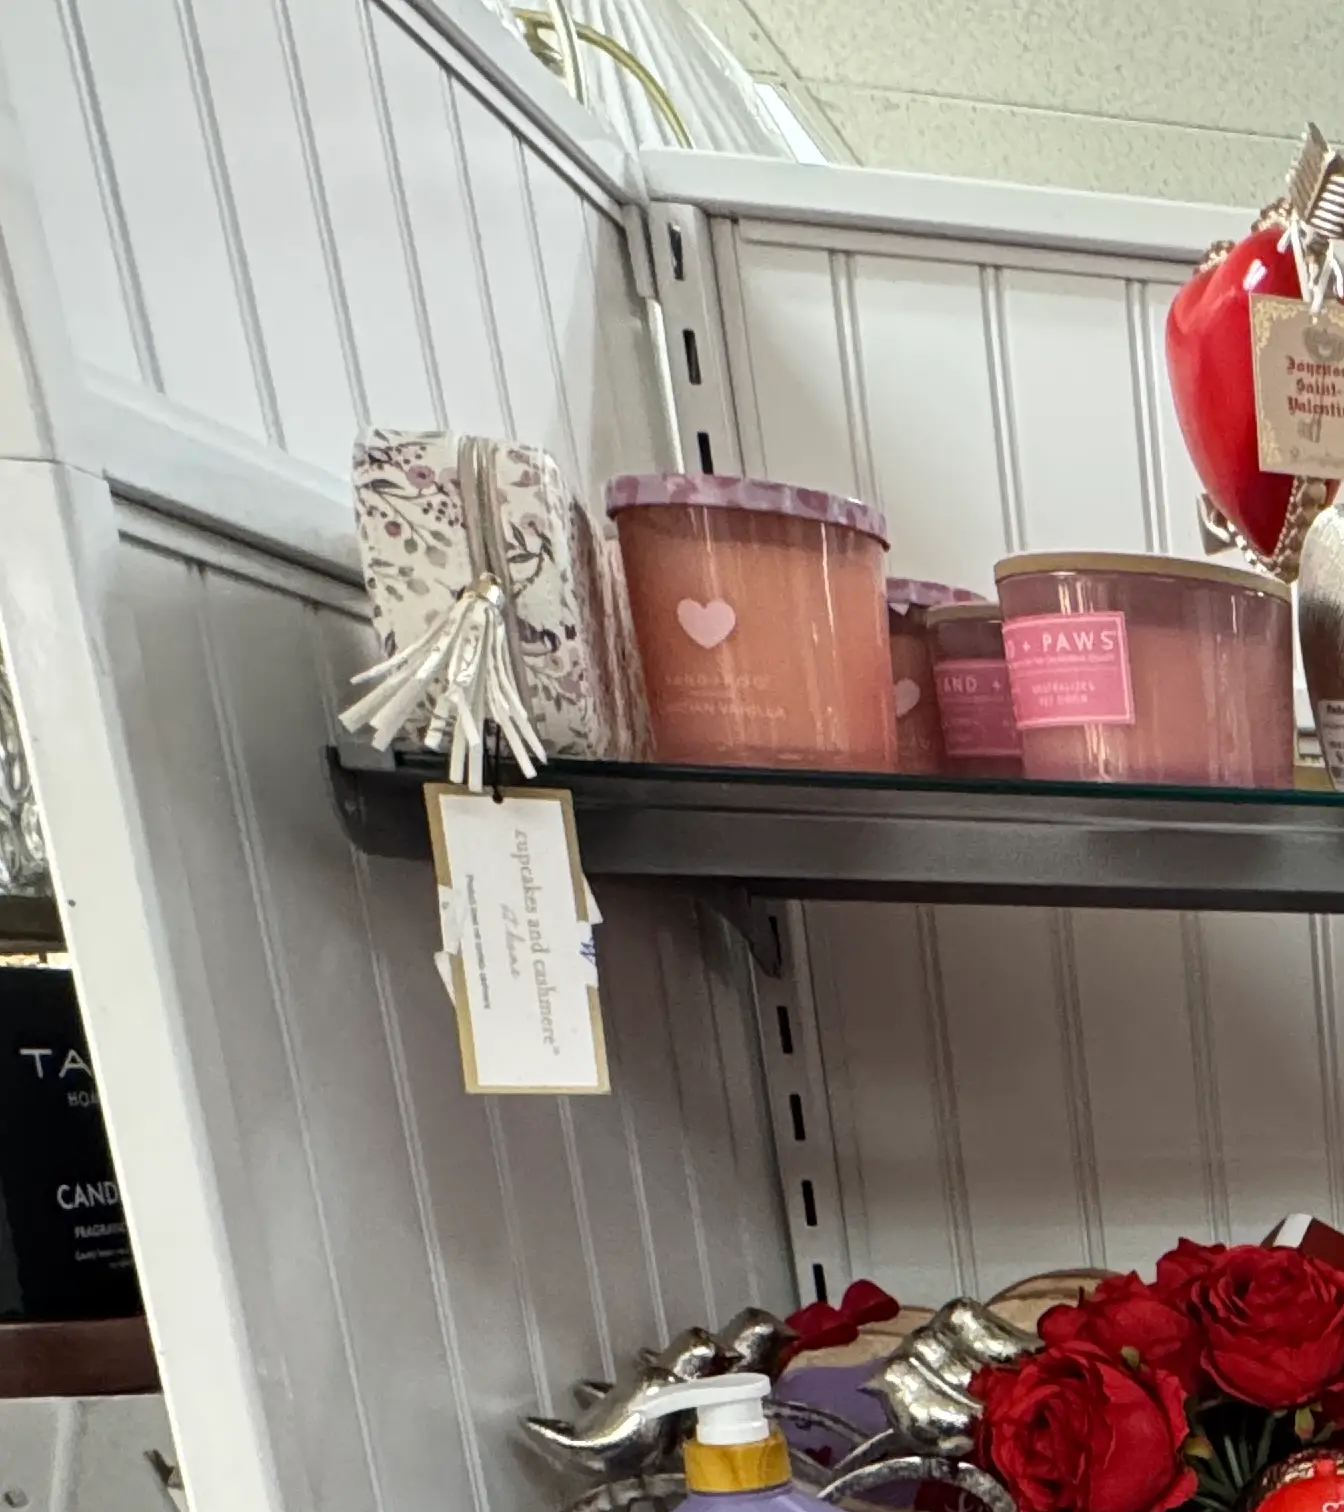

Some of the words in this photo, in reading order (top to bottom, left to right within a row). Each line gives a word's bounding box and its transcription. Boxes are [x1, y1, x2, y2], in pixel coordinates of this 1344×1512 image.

[1042, 631, 1117, 652] PAWS
[510, 829, 541, 917] cupcakes
[527, 918, 550, 954] and
[532, 957, 560, 1055] cashmere
[19, 1048, 93, 1078] TA
[56, 1181, 120, 1210] CAND
